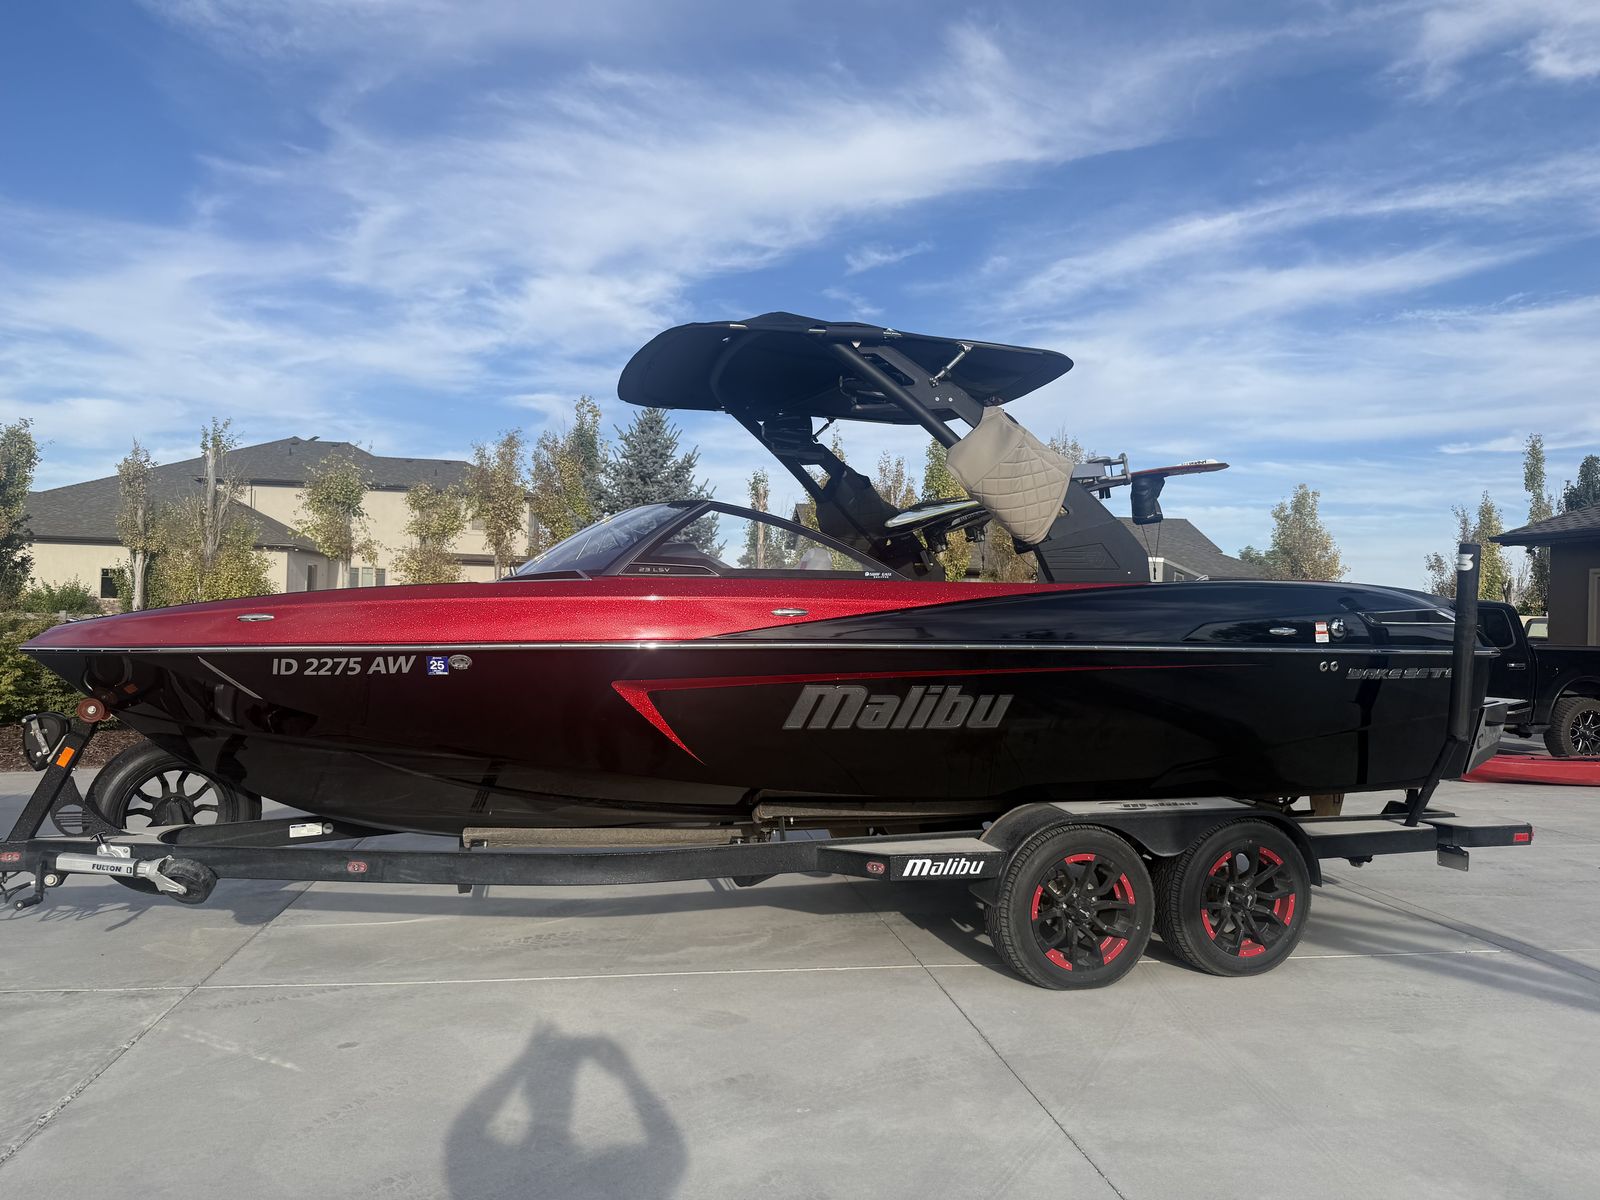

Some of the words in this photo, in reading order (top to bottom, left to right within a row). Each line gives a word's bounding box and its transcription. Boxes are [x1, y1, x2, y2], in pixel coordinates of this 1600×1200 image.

[272, 658, 298, 675] ID
[303, 657, 362, 676] 2275
[367, 655, 417, 675] AW
[430, 660, 445, 670] 25
[782, 685, 1014, 730] Malibu
[91, 863, 122, 872] FULTON
[902, 857, 985, 877] Malibu
